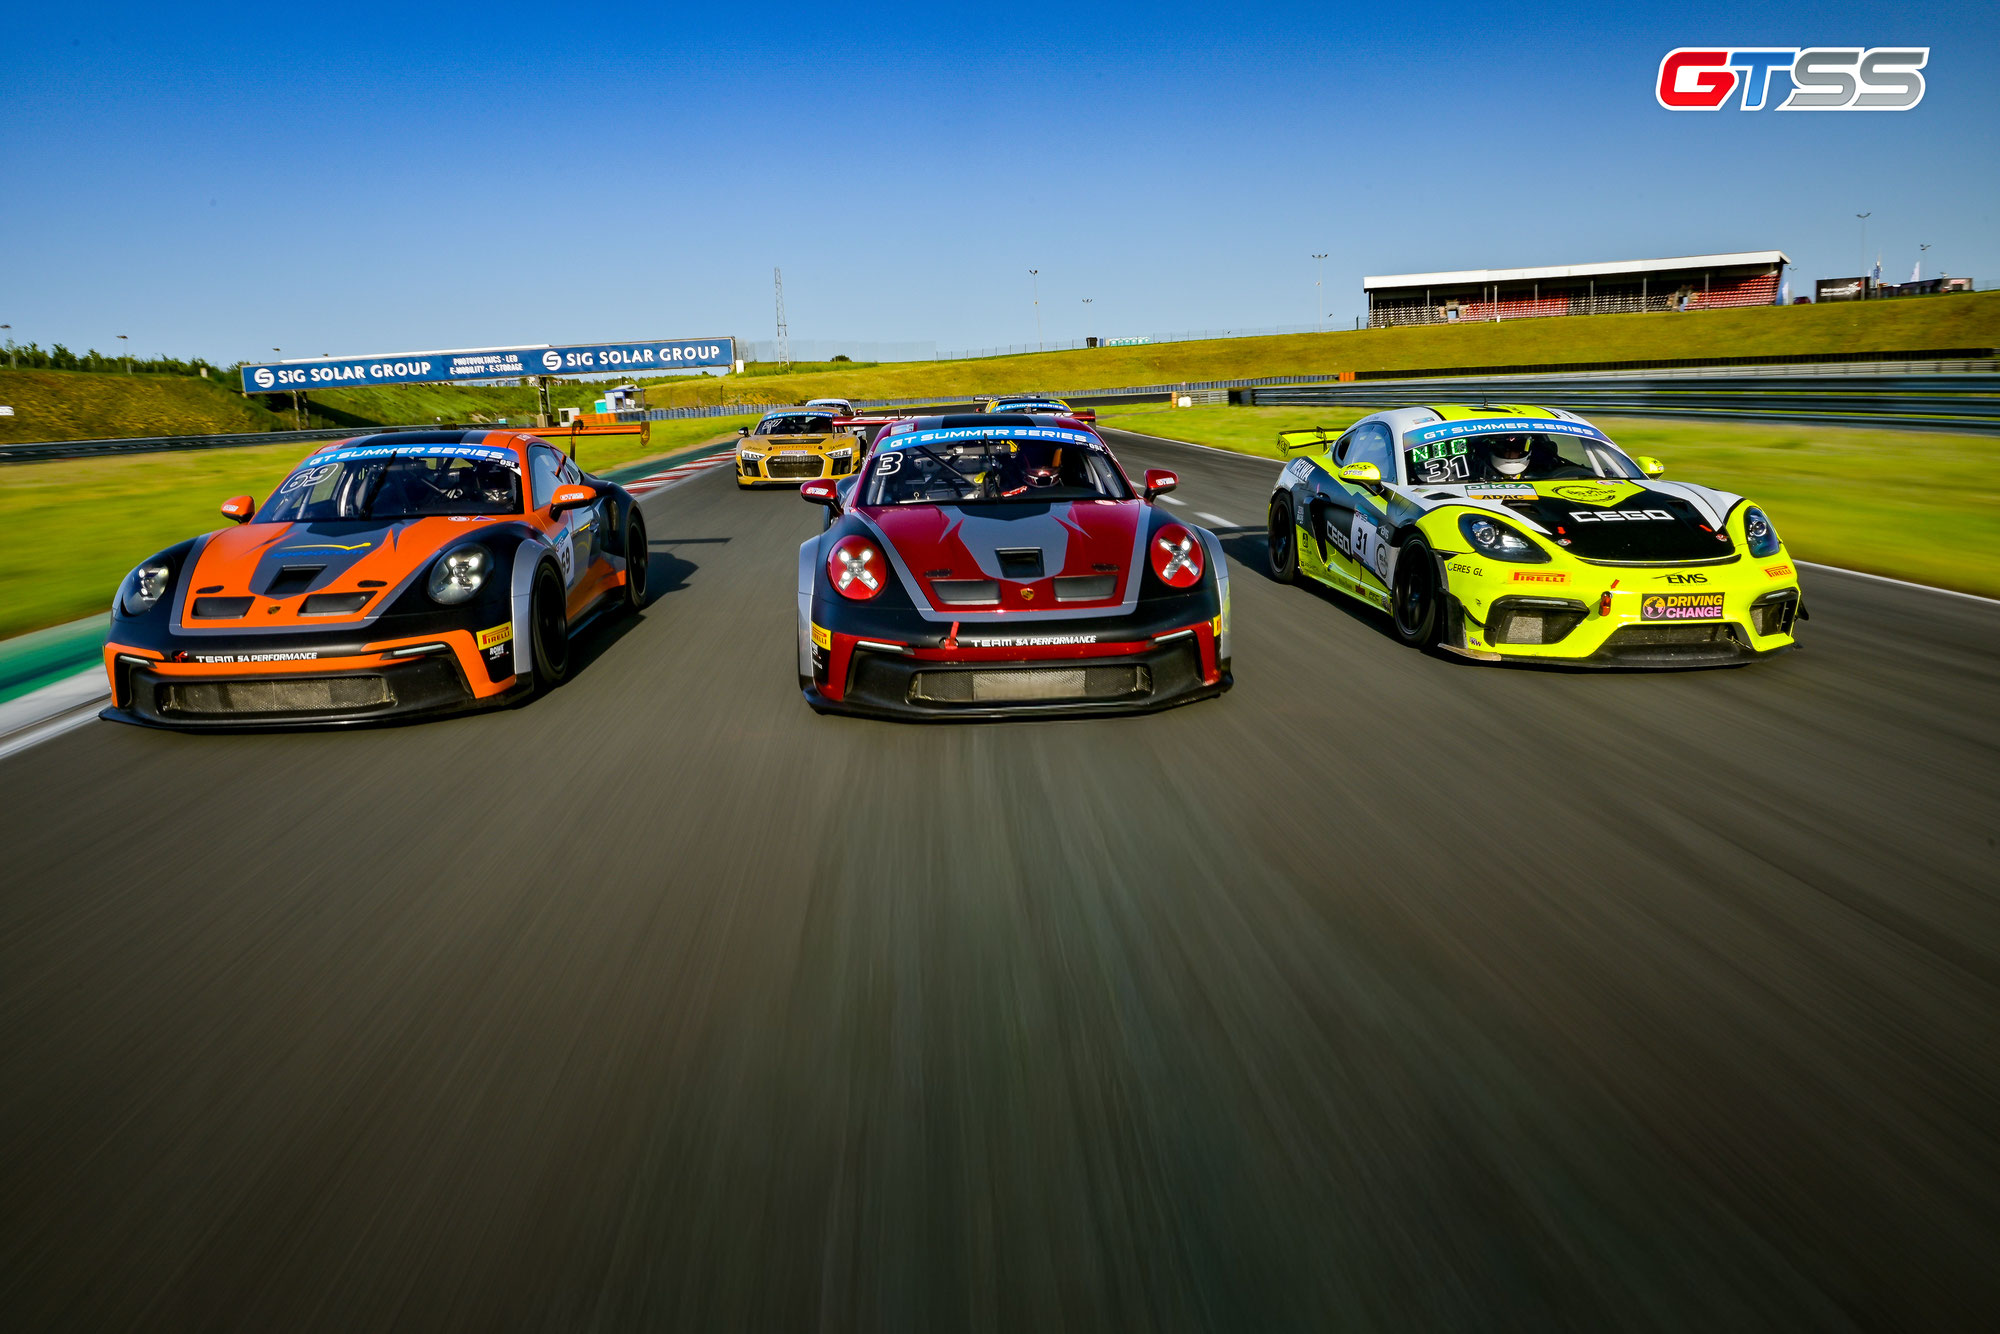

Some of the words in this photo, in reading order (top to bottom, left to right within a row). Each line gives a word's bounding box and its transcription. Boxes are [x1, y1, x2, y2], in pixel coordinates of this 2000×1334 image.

[599, 349, 654, 365] SOLAR
[659, 345, 720, 362] GROUP
[311, 366, 366, 382] SOLAR
[370, 361, 431, 379] GROUP
[890, 436, 917, 448] GT
[921, 429, 1011, 442] SUMMER
[1019, 430, 1087, 443] SERIES
[1423, 428, 1448, 440] GT
[1449, 422, 1530, 434] SUMMER
[1532, 423, 1595, 436] SERIES
[309, 454, 336, 466] GT
[336, 447, 425, 459] SUMMER
[427, 447, 505, 459] SERIES
[876, 451, 904, 476] 3
[280, 462, 339, 494] 69
[1424, 455, 1470, 483] 31
[1568, 509, 1676, 523] CEGO
[1327, 519, 1351, 555] CEGO
[1355, 526, 1368, 556] 31
[1447, 562, 1471, 574] CERES
[1473, 567, 1484, 577] GL
[1513, 571, 1566, 583] PIRELLI
[1667, 573, 1708, 584] EMS
[1764, 565, 1793, 578] PIRELLI
[1667, 595, 1723, 607] DRIVING
[1665, 606, 1722, 618] CHANGE
[482, 626, 510, 645] PIRELLI
[971, 639, 1012, 648] TEAM
[1030, 635, 1097, 646] PERFORMANCE
[195, 655, 234, 664] TEAM
[251, 652, 318, 662] PERFORMANCE
